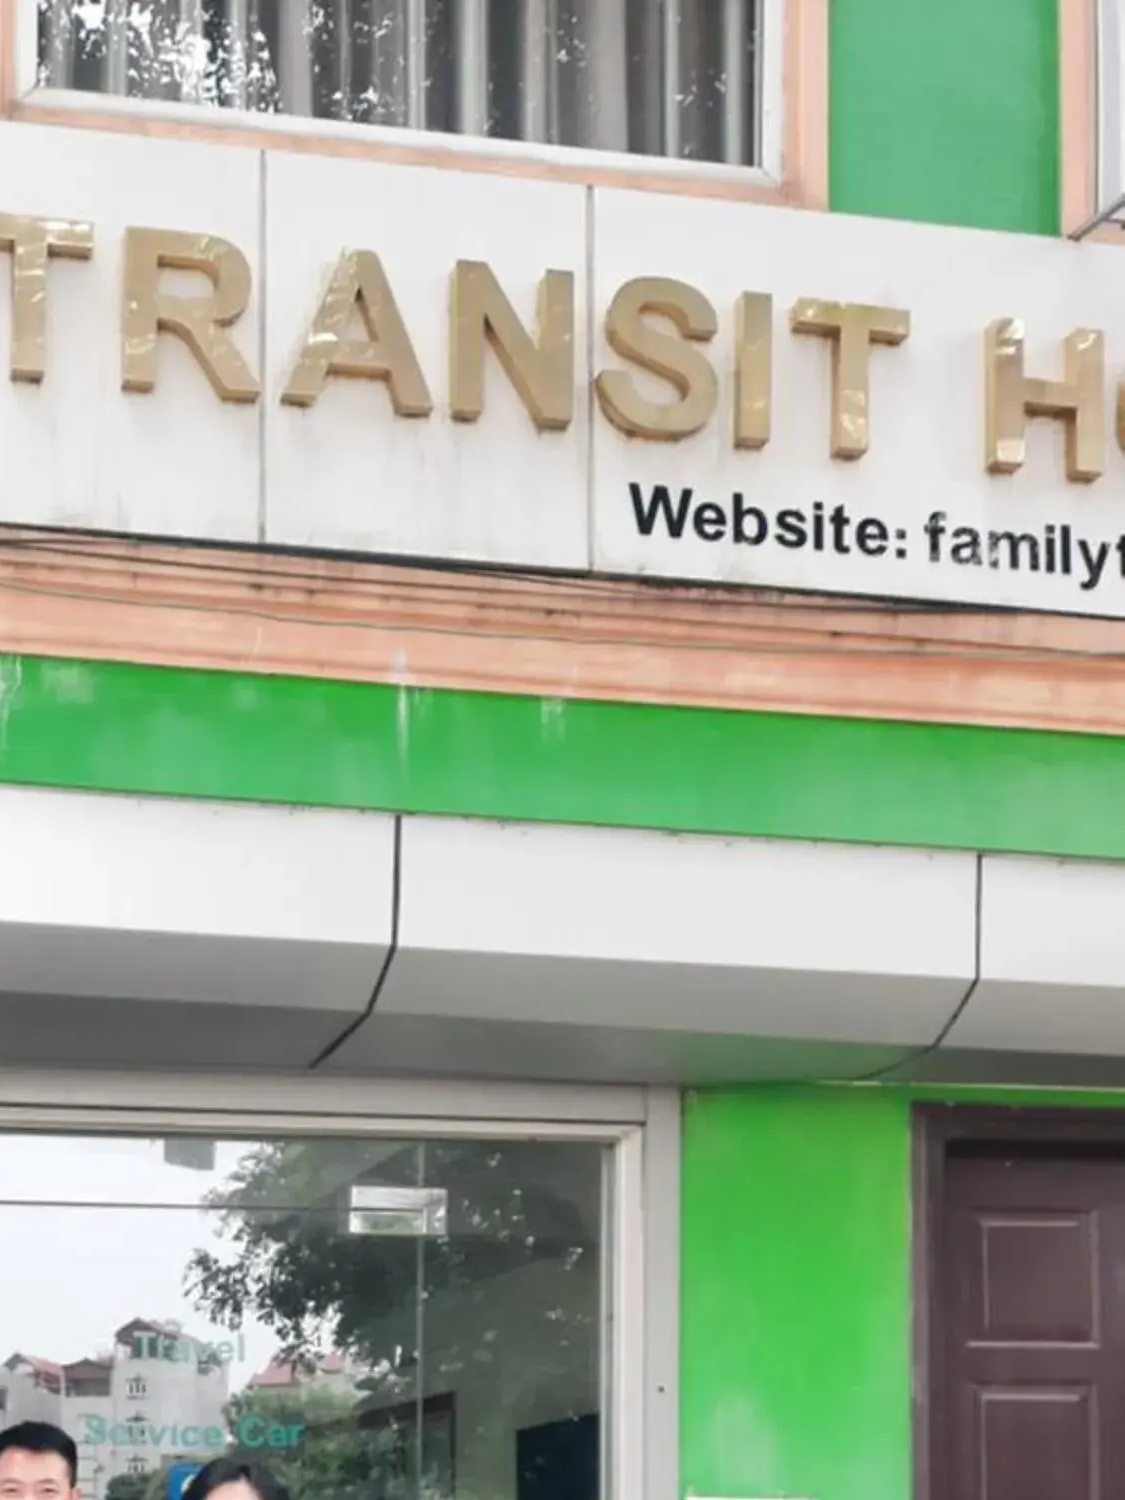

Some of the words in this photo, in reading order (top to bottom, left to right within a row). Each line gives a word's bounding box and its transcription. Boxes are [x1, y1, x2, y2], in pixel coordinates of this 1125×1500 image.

[984, 316, 1125, 484] H
[628, 481, 908, 559] Website:
[133, 1330, 246, 1362] Travel
[83, 1413, 224, 1448] Service
[236, 1412, 306, 1447] Car
